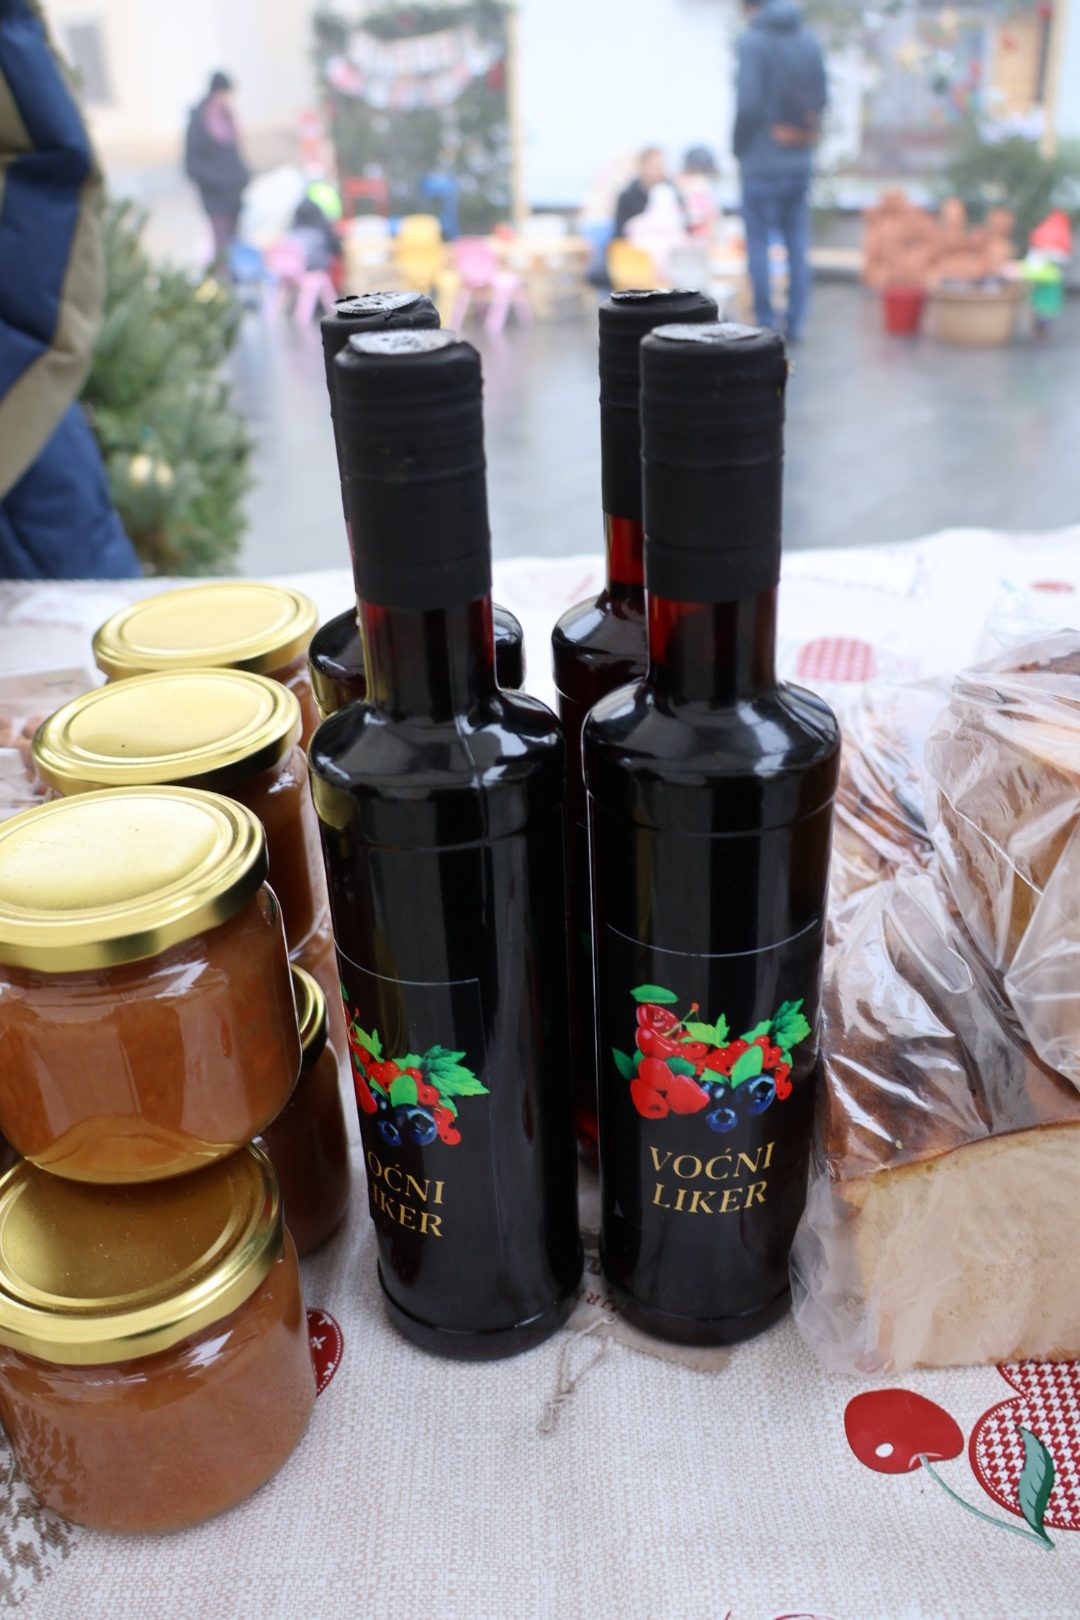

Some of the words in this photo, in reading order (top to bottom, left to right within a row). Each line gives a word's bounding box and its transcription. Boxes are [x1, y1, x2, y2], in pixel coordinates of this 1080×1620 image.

[367, 1151, 447, 1205] OĆNI
[649, 1141, 776, 1181] VOĆNI
[372, 1183, 444, 1238] IKER
[652, 1180, 768, 1214] LIKER
